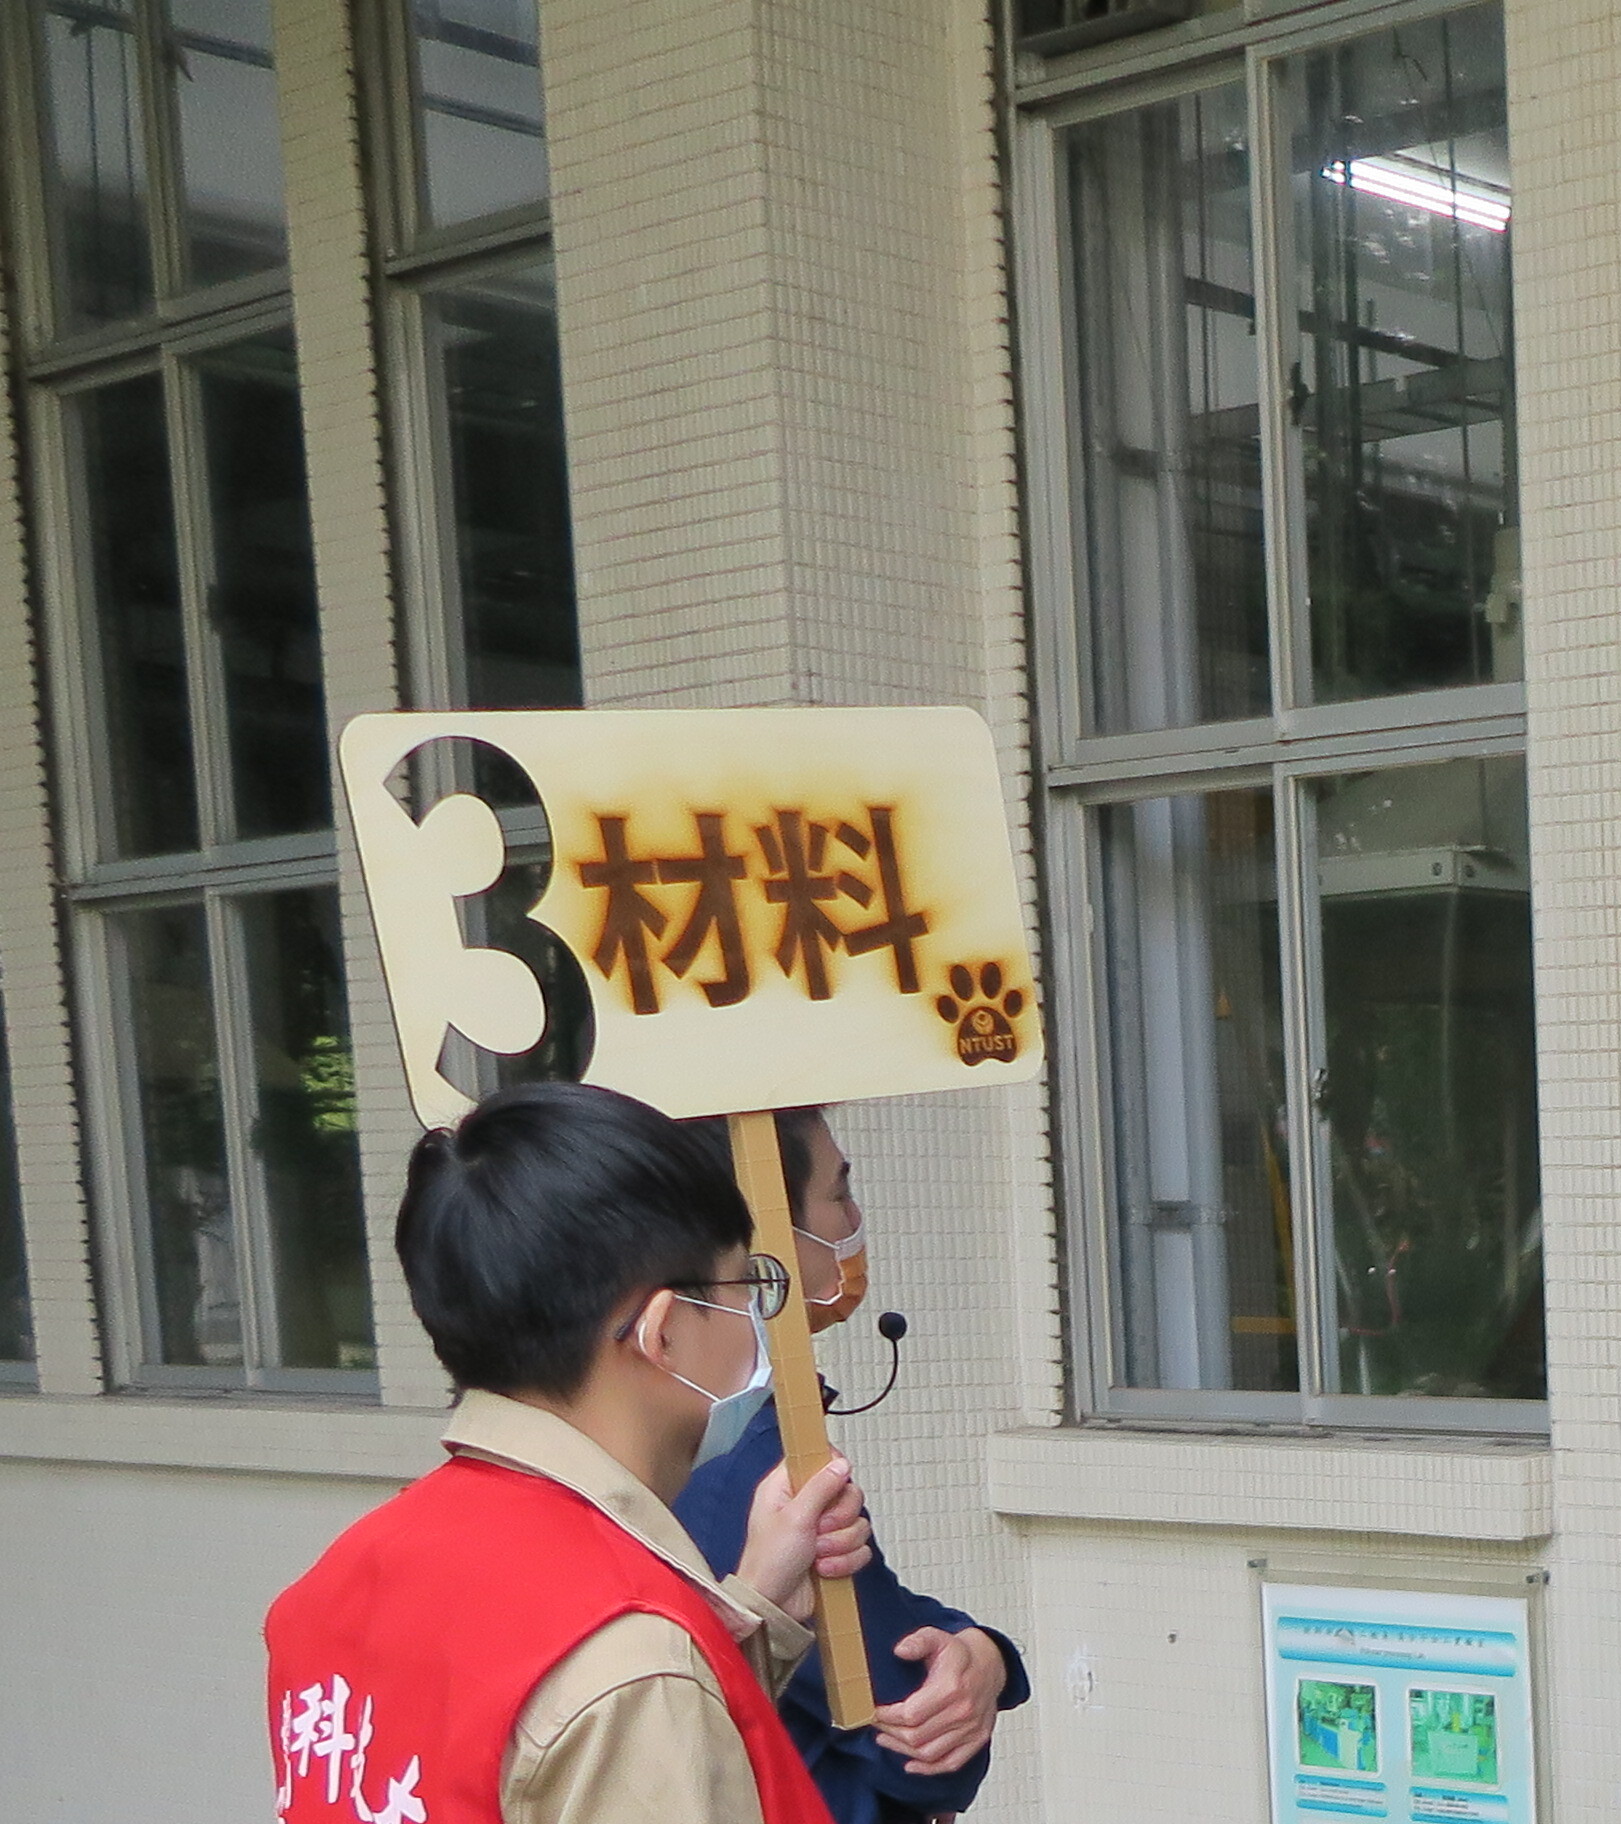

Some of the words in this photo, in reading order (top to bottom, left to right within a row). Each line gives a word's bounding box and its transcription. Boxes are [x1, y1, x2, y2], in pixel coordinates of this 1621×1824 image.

[383, 736, 597, 1100] 3
[578, 806, 929, 1015] 材料
[959, 1033, 1014, 1054] NTUST
